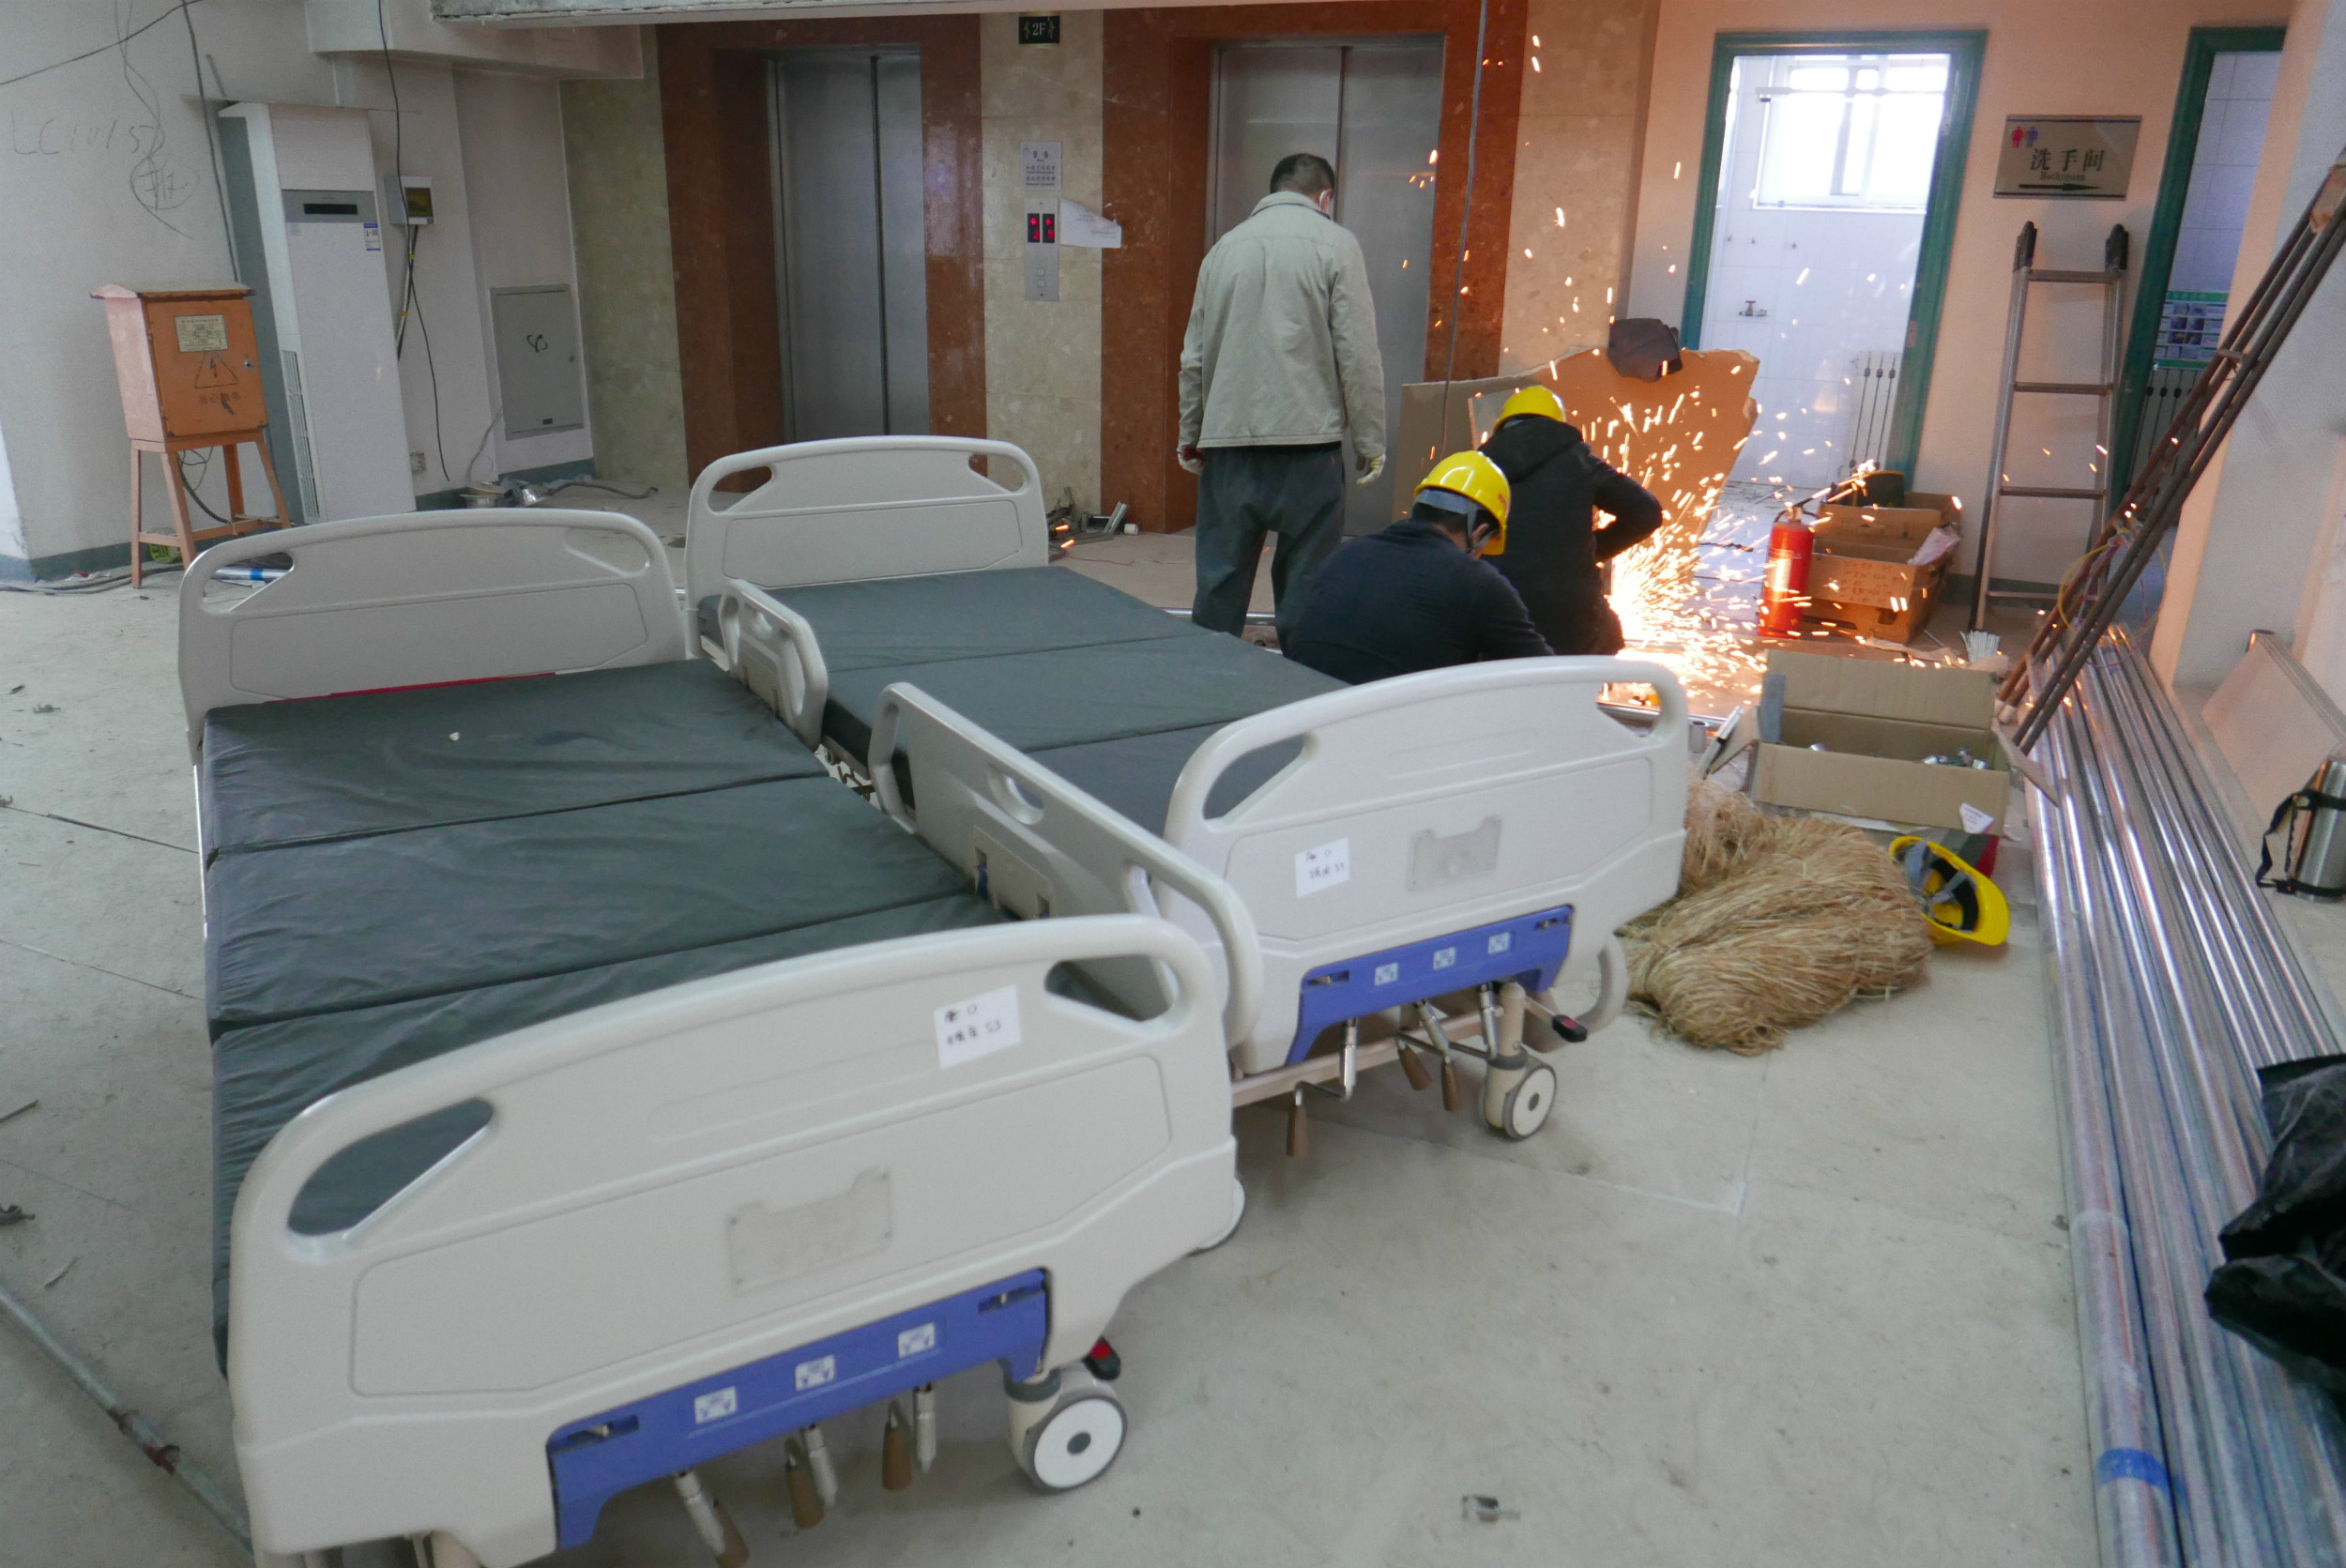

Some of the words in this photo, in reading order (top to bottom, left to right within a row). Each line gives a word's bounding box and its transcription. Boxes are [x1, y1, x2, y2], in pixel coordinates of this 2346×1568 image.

[1031, 22, 1046, 36] 2F
[2030, 147, 2106, 173] 洗手间
